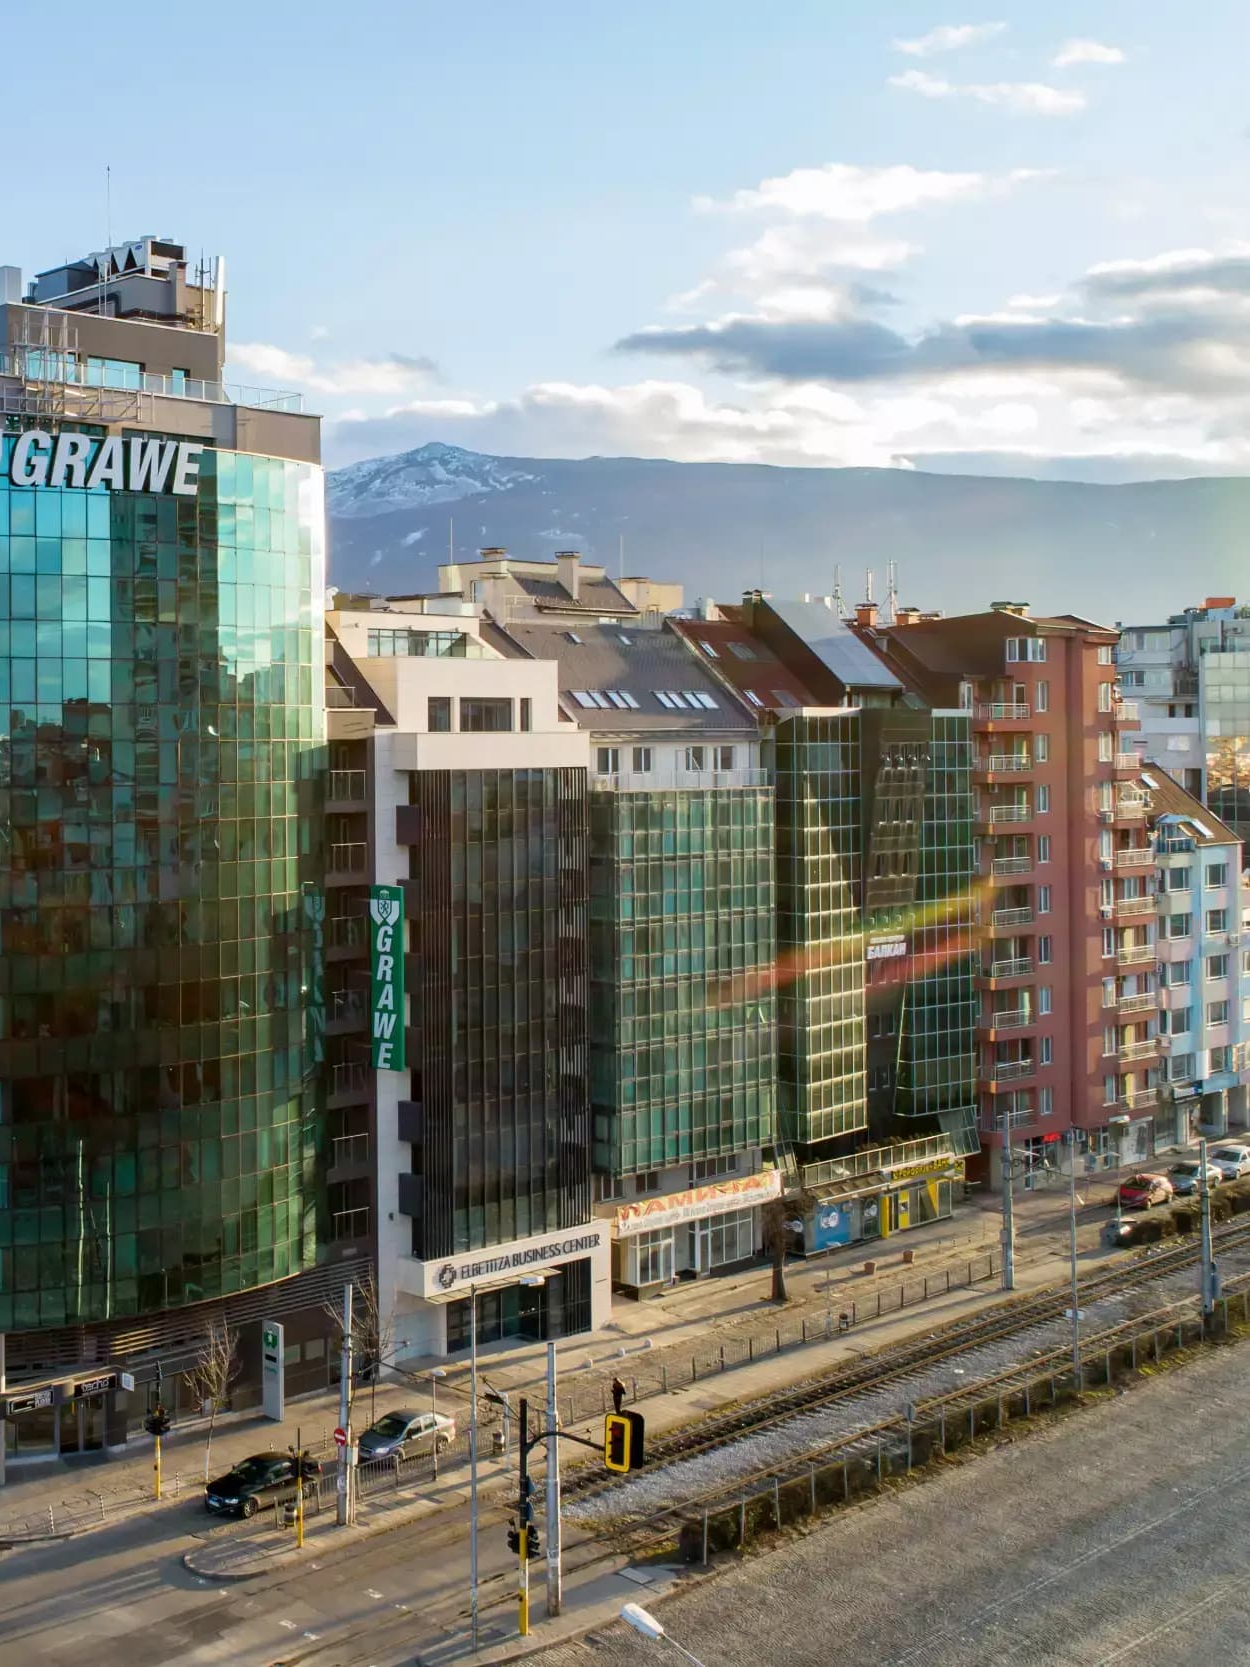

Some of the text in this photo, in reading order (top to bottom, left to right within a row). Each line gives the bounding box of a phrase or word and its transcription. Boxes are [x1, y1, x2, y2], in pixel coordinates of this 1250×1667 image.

[11, 430, 204, 496] GRAWE
[373, 925, 397, 1069] GRAWE
[461, 1233, 601, 1279] ELBETITZA BUSINESS CENTER
